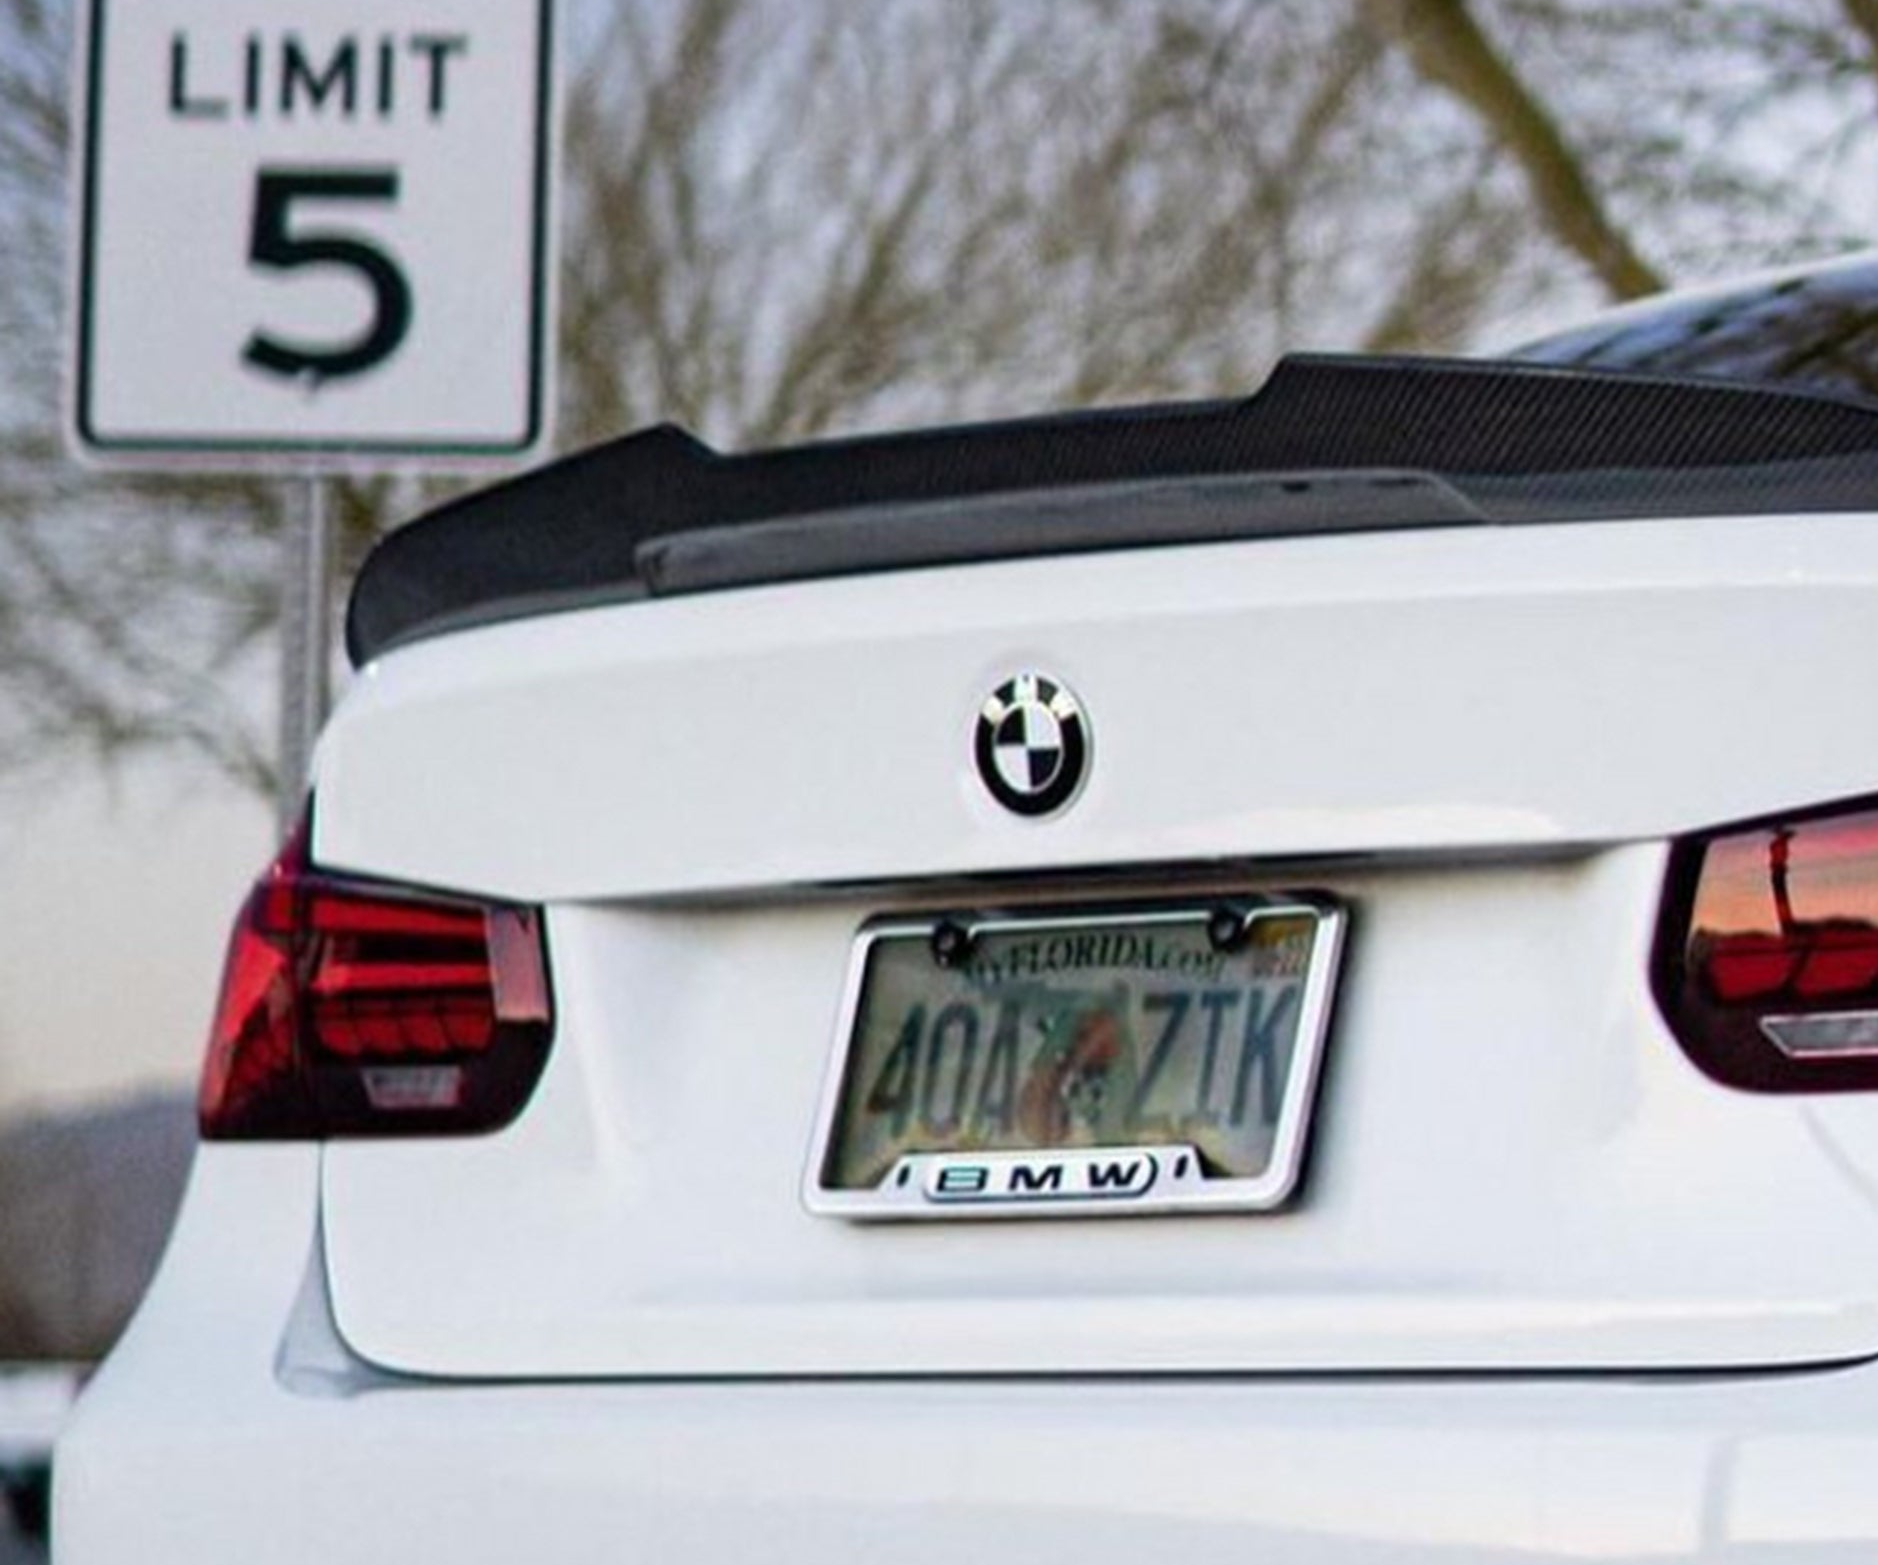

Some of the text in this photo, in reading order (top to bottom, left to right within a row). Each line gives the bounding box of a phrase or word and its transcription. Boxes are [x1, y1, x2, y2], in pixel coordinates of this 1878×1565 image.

[168, 34, 466, 118] LIMIT
[241, 168, 413, 389] 5
[935, 1160, 1142, 1193] BMW
